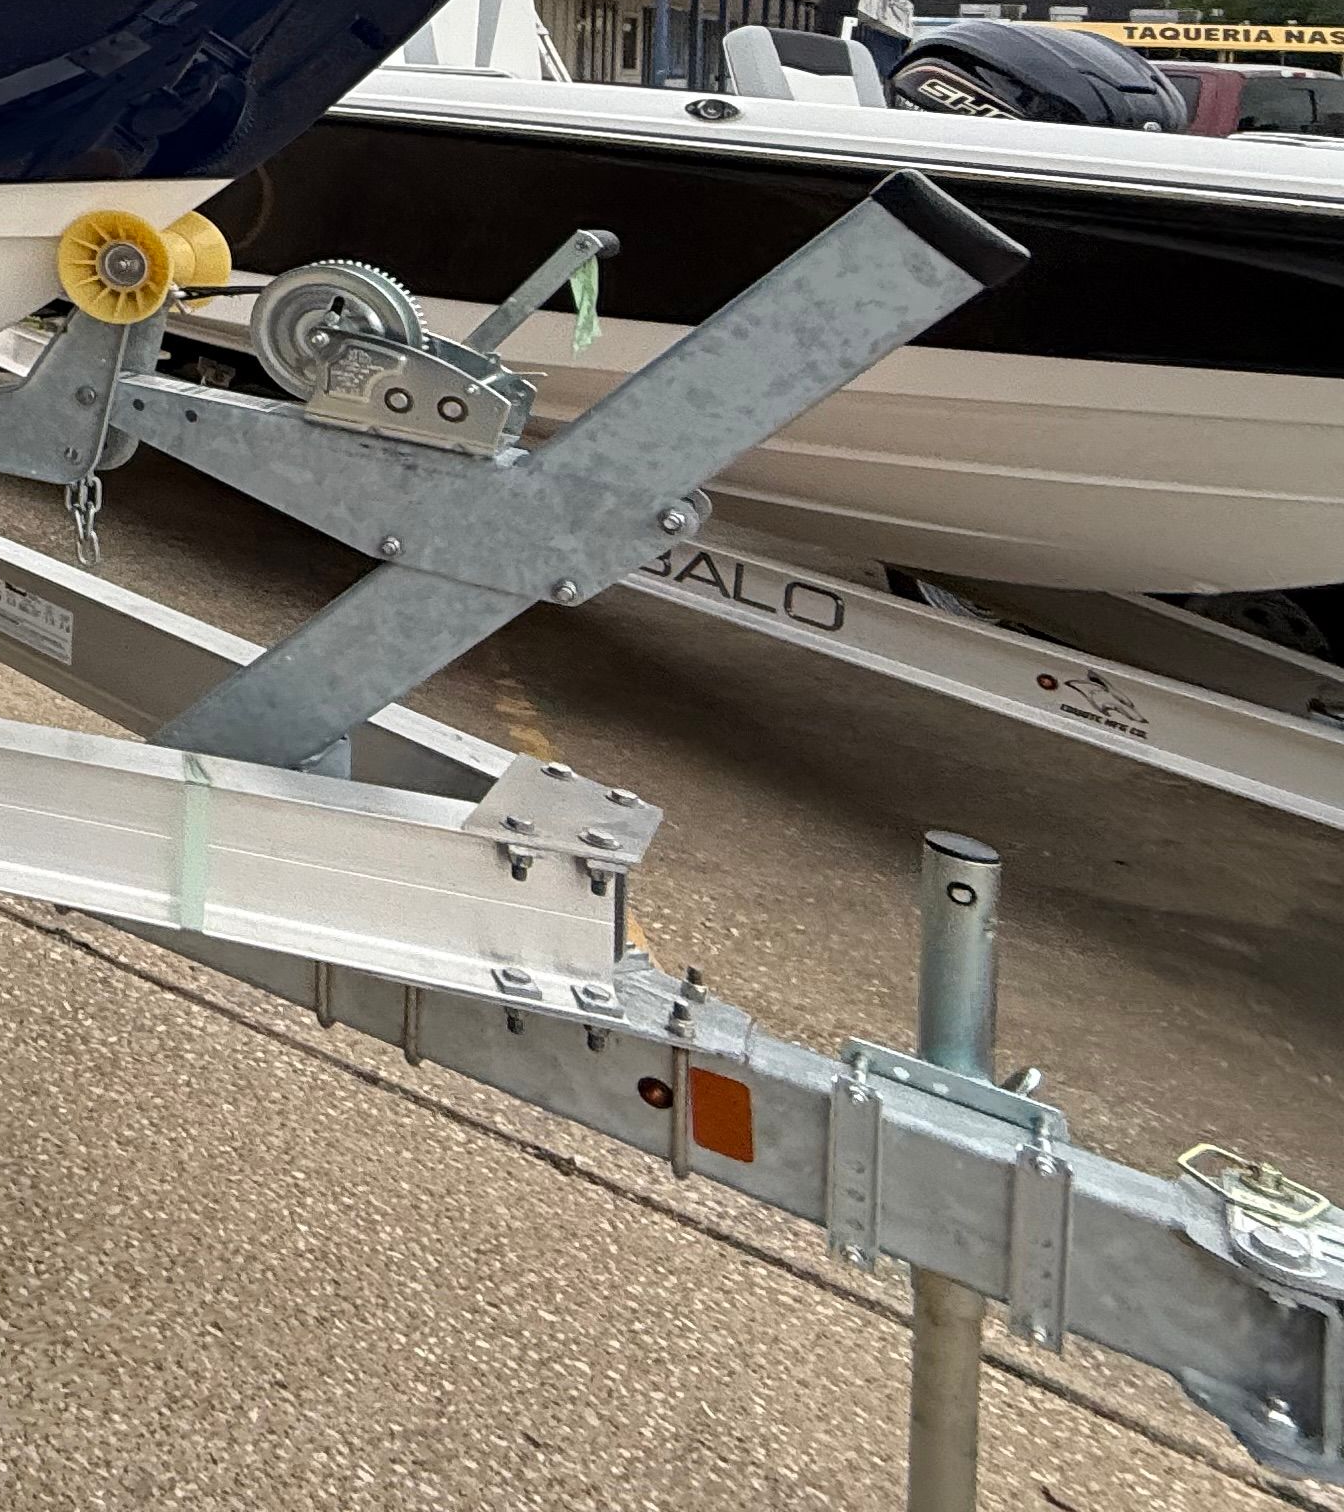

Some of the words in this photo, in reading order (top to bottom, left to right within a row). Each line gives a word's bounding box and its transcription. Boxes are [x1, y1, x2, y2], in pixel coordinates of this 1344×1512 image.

[1123, 25, 1275, 43] TAQUERIA
[1284, 29, 1344, 45] NAS
[918, 78, 1020, 121] SH
